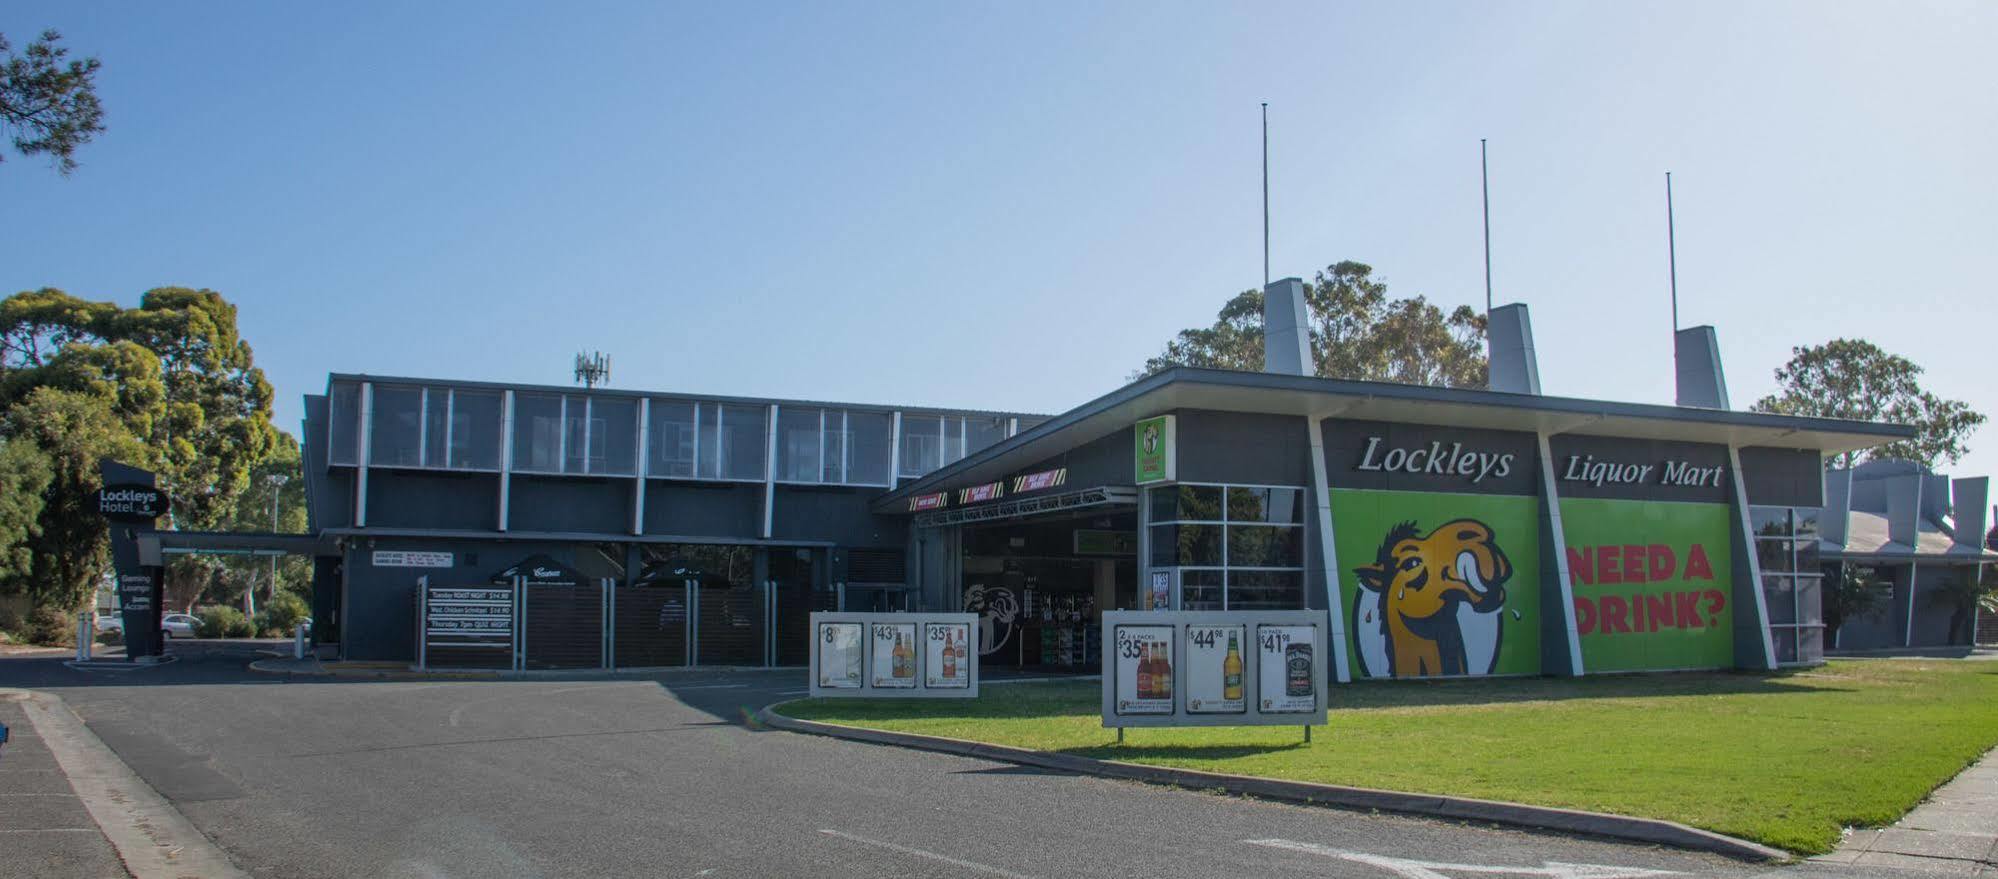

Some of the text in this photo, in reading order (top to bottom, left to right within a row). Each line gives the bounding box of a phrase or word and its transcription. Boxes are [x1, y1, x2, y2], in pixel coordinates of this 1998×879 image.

[1358, 436, 1514, 483] Lockleys
[1564, 454, 1723, 486] Liquor Mart
[100, 489, 157, 504] Lockleys
[100, 502, 133, 512] Hotel
[1567, 544, 1715, 585] NEED A
[1573, 590, 1726, 636] DRINK?
